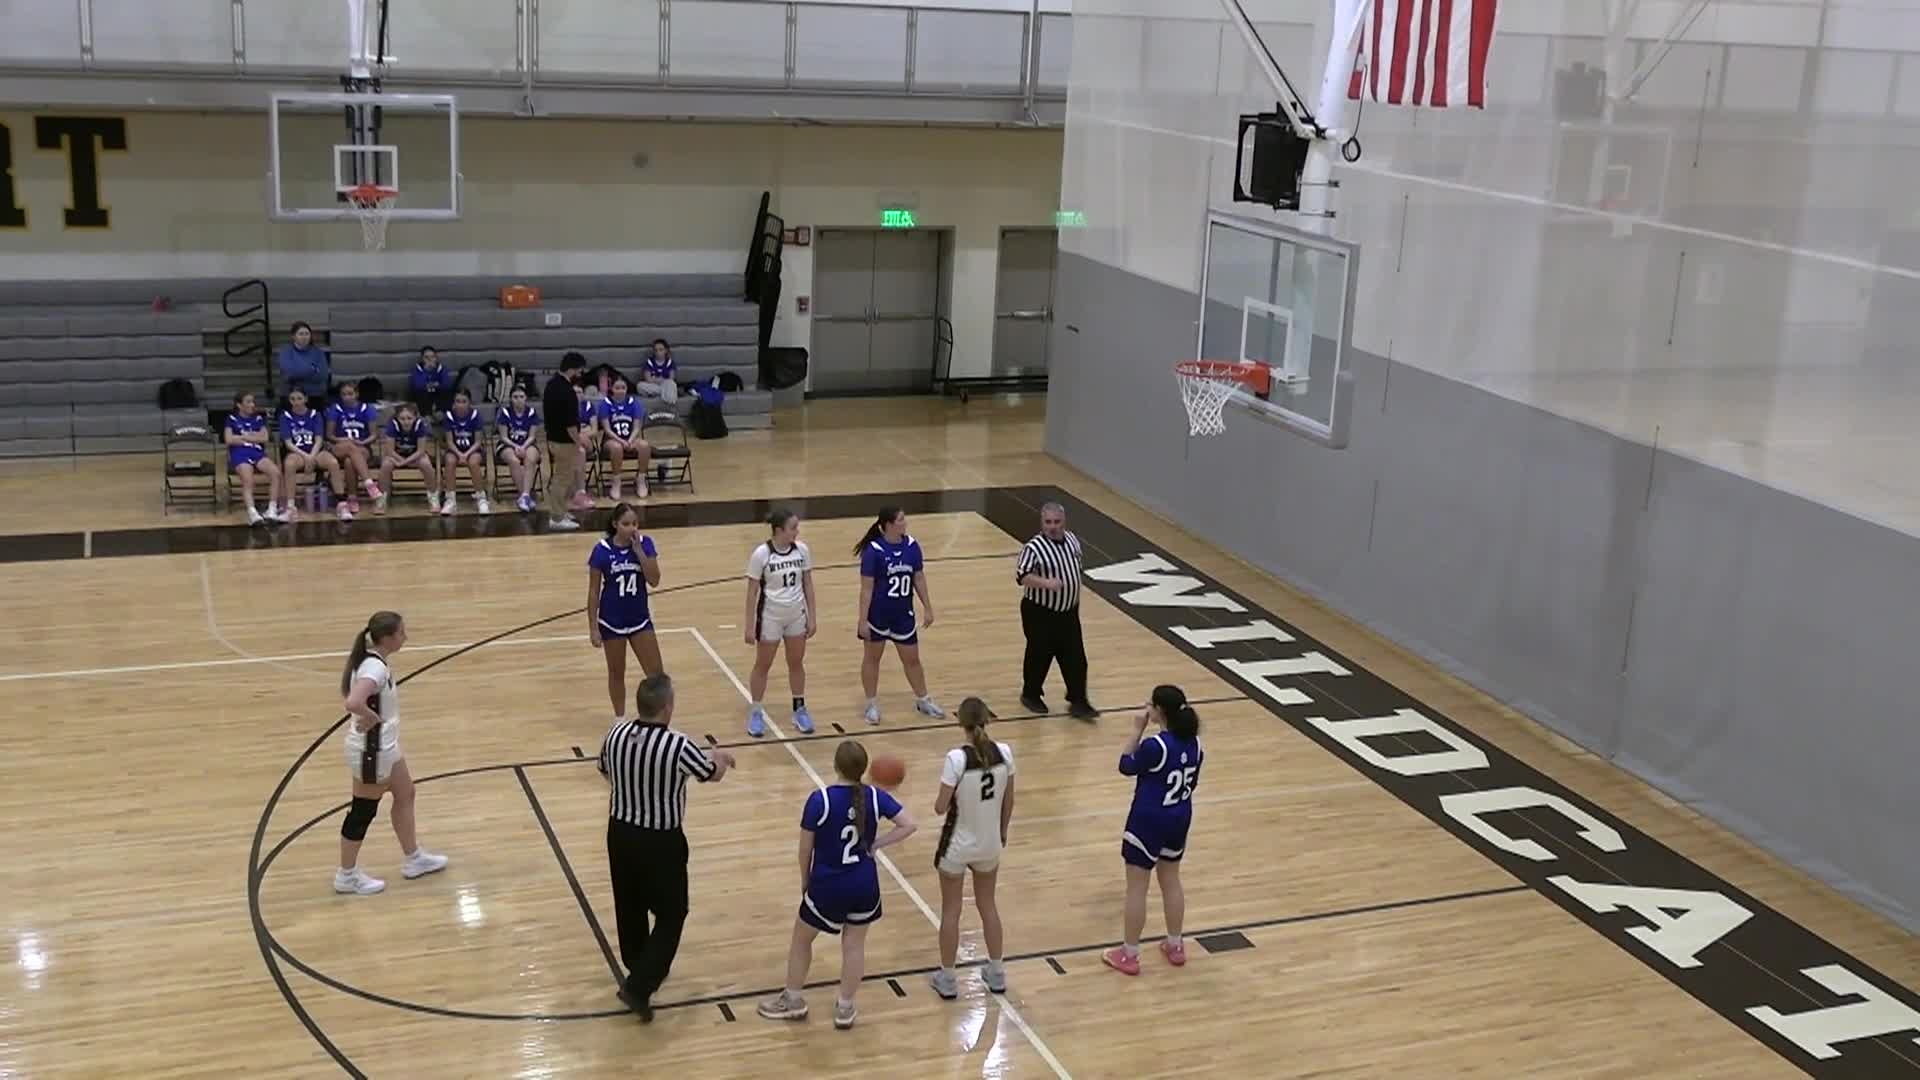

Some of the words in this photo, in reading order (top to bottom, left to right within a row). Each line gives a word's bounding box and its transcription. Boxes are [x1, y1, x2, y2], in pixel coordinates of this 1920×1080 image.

[615, 573, 637, 596] 14
[783, 572, 796, 588] 13
[887, 575, 911, 598] 20
[980, 772, 995, 802] 2
[1162, 766, 1197, 807] 25
[840, 824, 860, 865] 2
